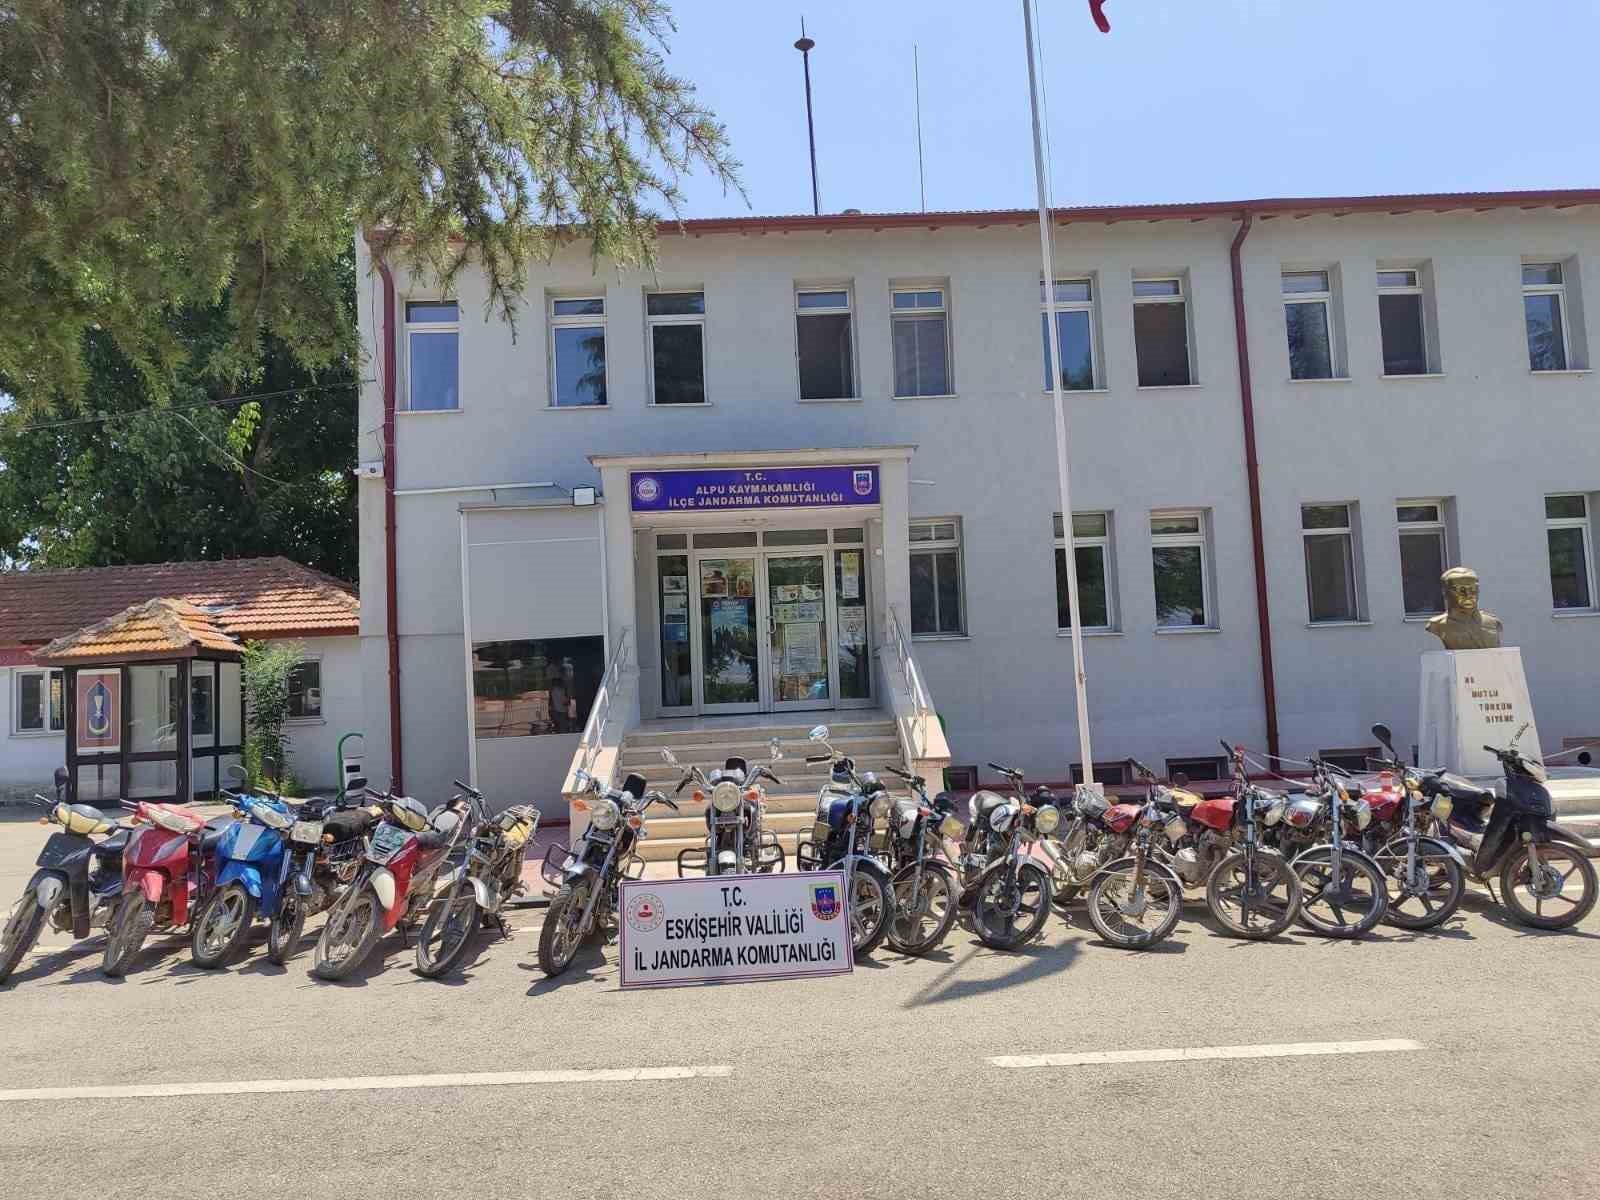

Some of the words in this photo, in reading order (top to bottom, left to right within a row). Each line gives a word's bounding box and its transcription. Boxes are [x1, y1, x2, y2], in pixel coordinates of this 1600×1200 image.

[744, 472, 767, 481] T.C.
[695, 485, 724, 494] ALPU
[728, 482, 815, 493] KAYMAKAMLIĞI
[668, 496, 694, 508] İLÇE
[698, 495, 760, 506] JANDARMA
[763, 492, 843, 504] KOMUTANLIĞI
[721, 887, 746, 907] T.C.
[665, 912, 742, 943] ESKİŞEHİR
[744, 908, 804, 935] VALİLİĞİ
[634, 948, 648, 971] İL
[651, 947, 734, 969] JANDARMA
[737, 937, 836, 966] KOMUTANLIĞI
